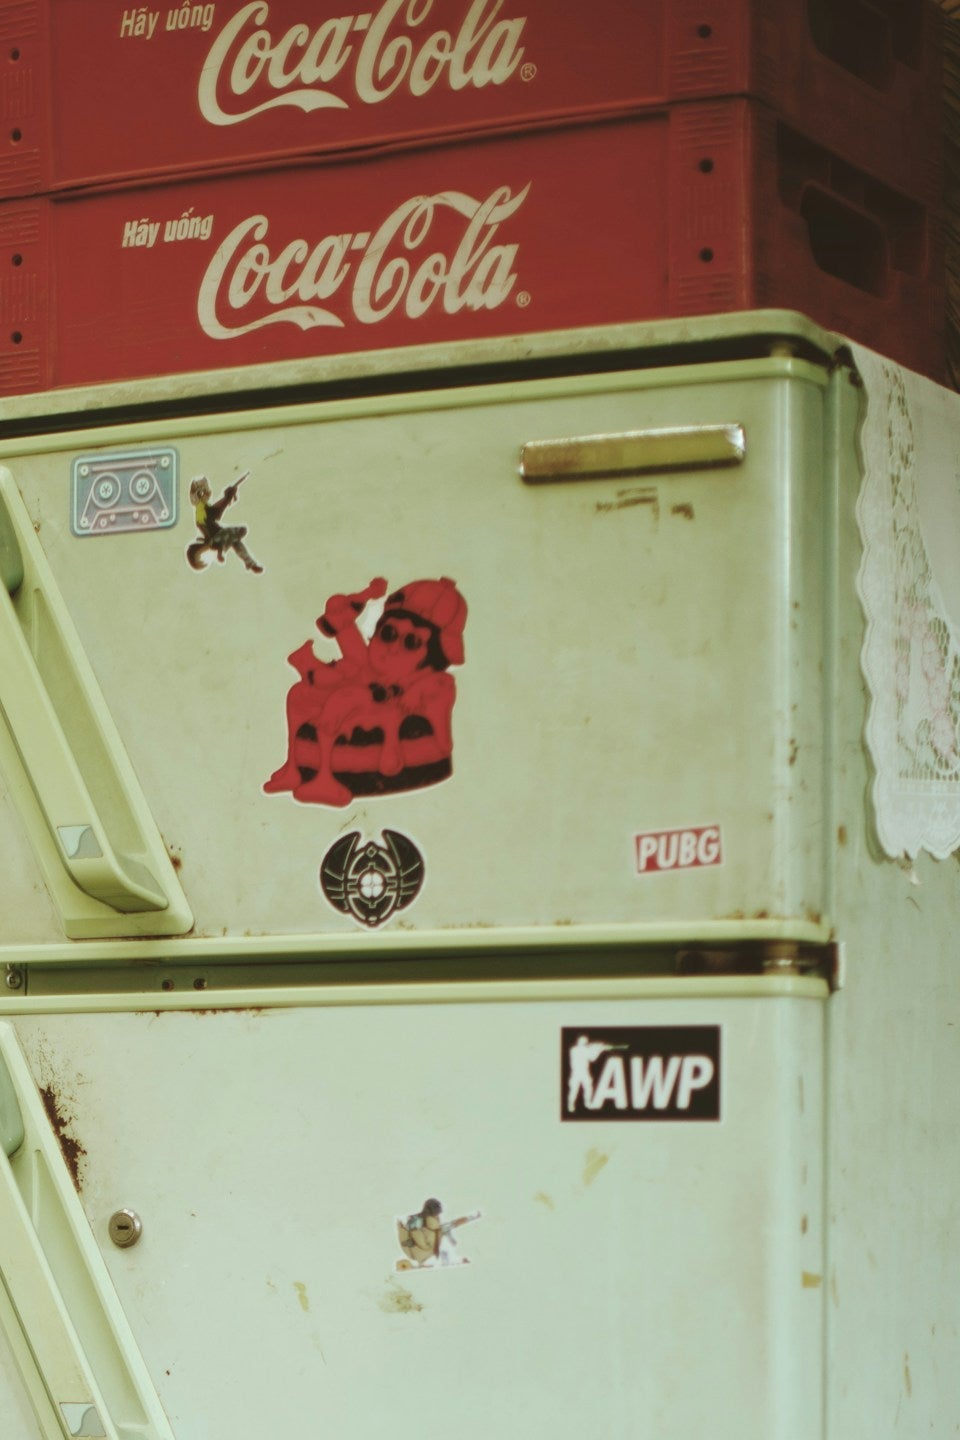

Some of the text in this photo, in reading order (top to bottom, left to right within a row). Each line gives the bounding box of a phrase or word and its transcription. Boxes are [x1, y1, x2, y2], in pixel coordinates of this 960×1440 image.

[119, 6, 160, 41] Hãy
[198, 0, 528, 126] Coca-Cola
[121, 180, 533, 340] Hãy uống Coca-Cola
[639, 828, 720, 871] PUBG
